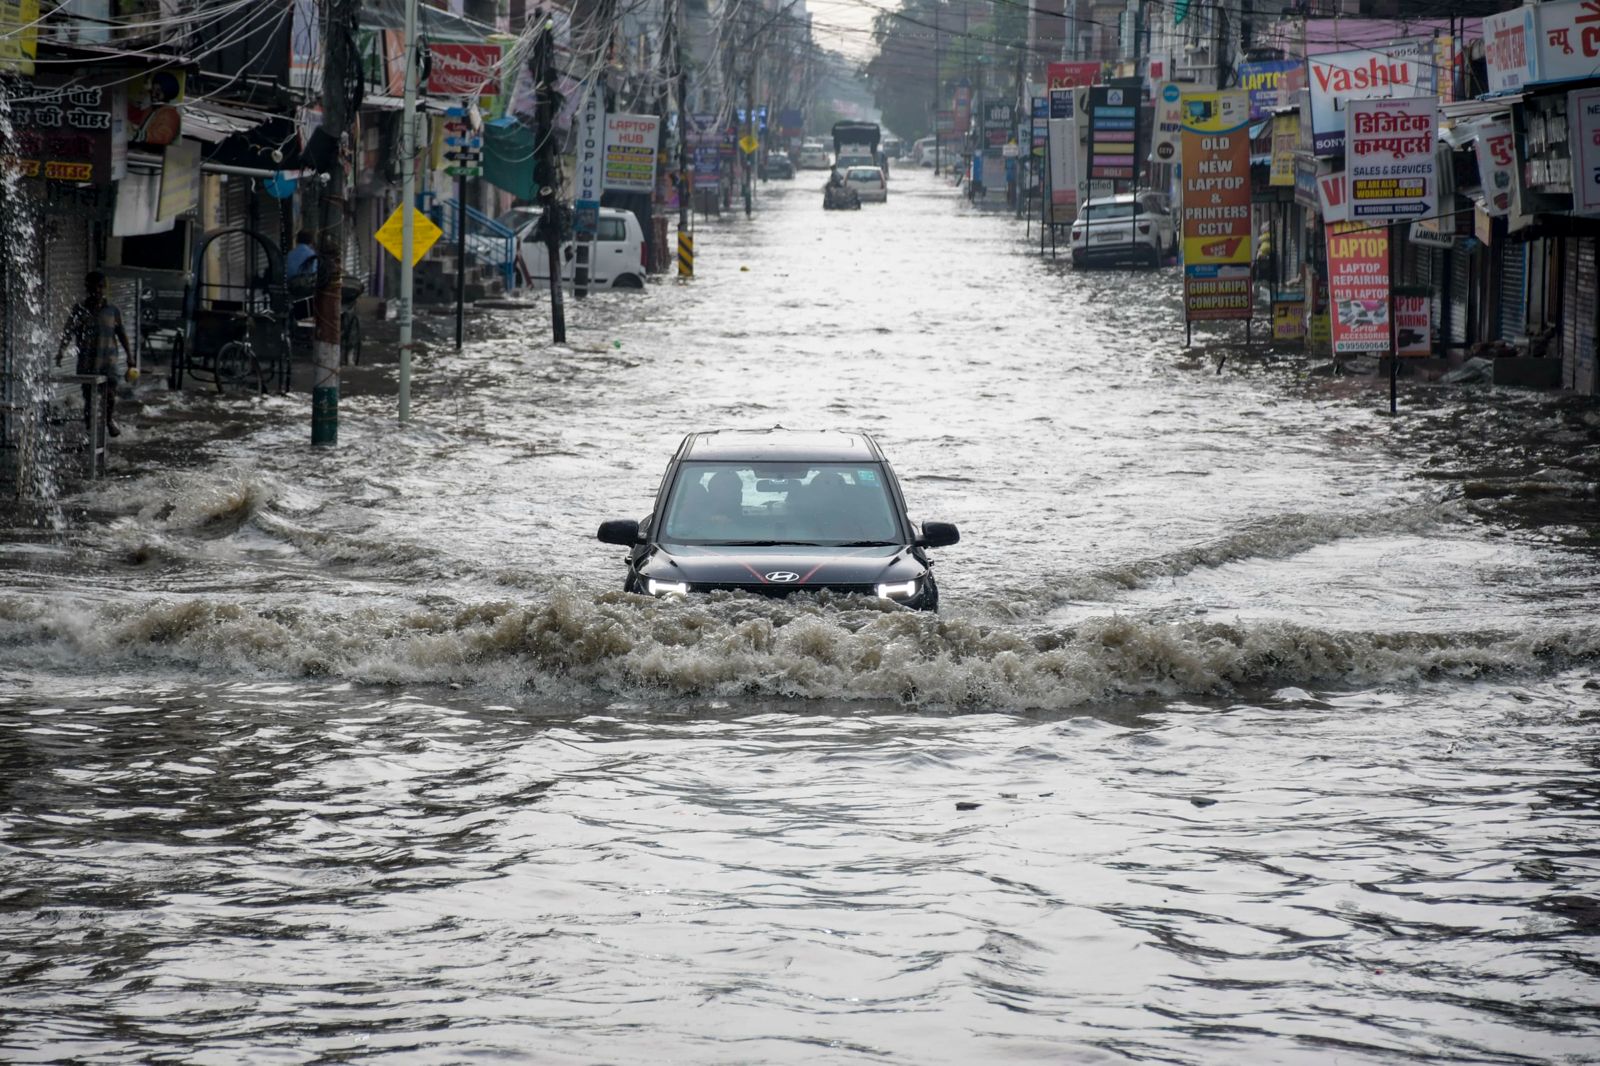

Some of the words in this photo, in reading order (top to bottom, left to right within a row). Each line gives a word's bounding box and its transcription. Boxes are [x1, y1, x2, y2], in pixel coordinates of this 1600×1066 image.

[1312, 57, 1409, 93] Vashu
[609, 119, 657, 134] LAPTOP
[1354, 110, 1431, 134] डिजिटेक
[618, 133, 645, 145] HUB
[1201, 137, 1230, 150] OLD
[1315, 137, 1345, 149] SONY
[1198, 160, 1233, 173] NEW
[1353, 166, 1381, 177] SALES
[1382, 165, 1390, 175] &
[1391, 163, 1432, 175] SERVICES
[1187, 176, 1245, 191] LAPTOP
[1211, 193, 1222, 204] &
[1185, 205, 1248, 220] PRINTERS
[1198, 222, 1233, 235] CCTV
[1415, 229, 1451, 243] LAMINATION
[1330, 239, 1388, 259] LAPTOP
[1340, 263, 1380, 273] LAPTOP
[1189, 281, 1216, 294] GURU
[1218, 280, 1247, 293] KRIPA
[1333, 275, 1389, 286] REPAIRING
[1354, 289, 1389, 299] LAPTOP
[1189, 295, 1248, 309] COMPUTERS
